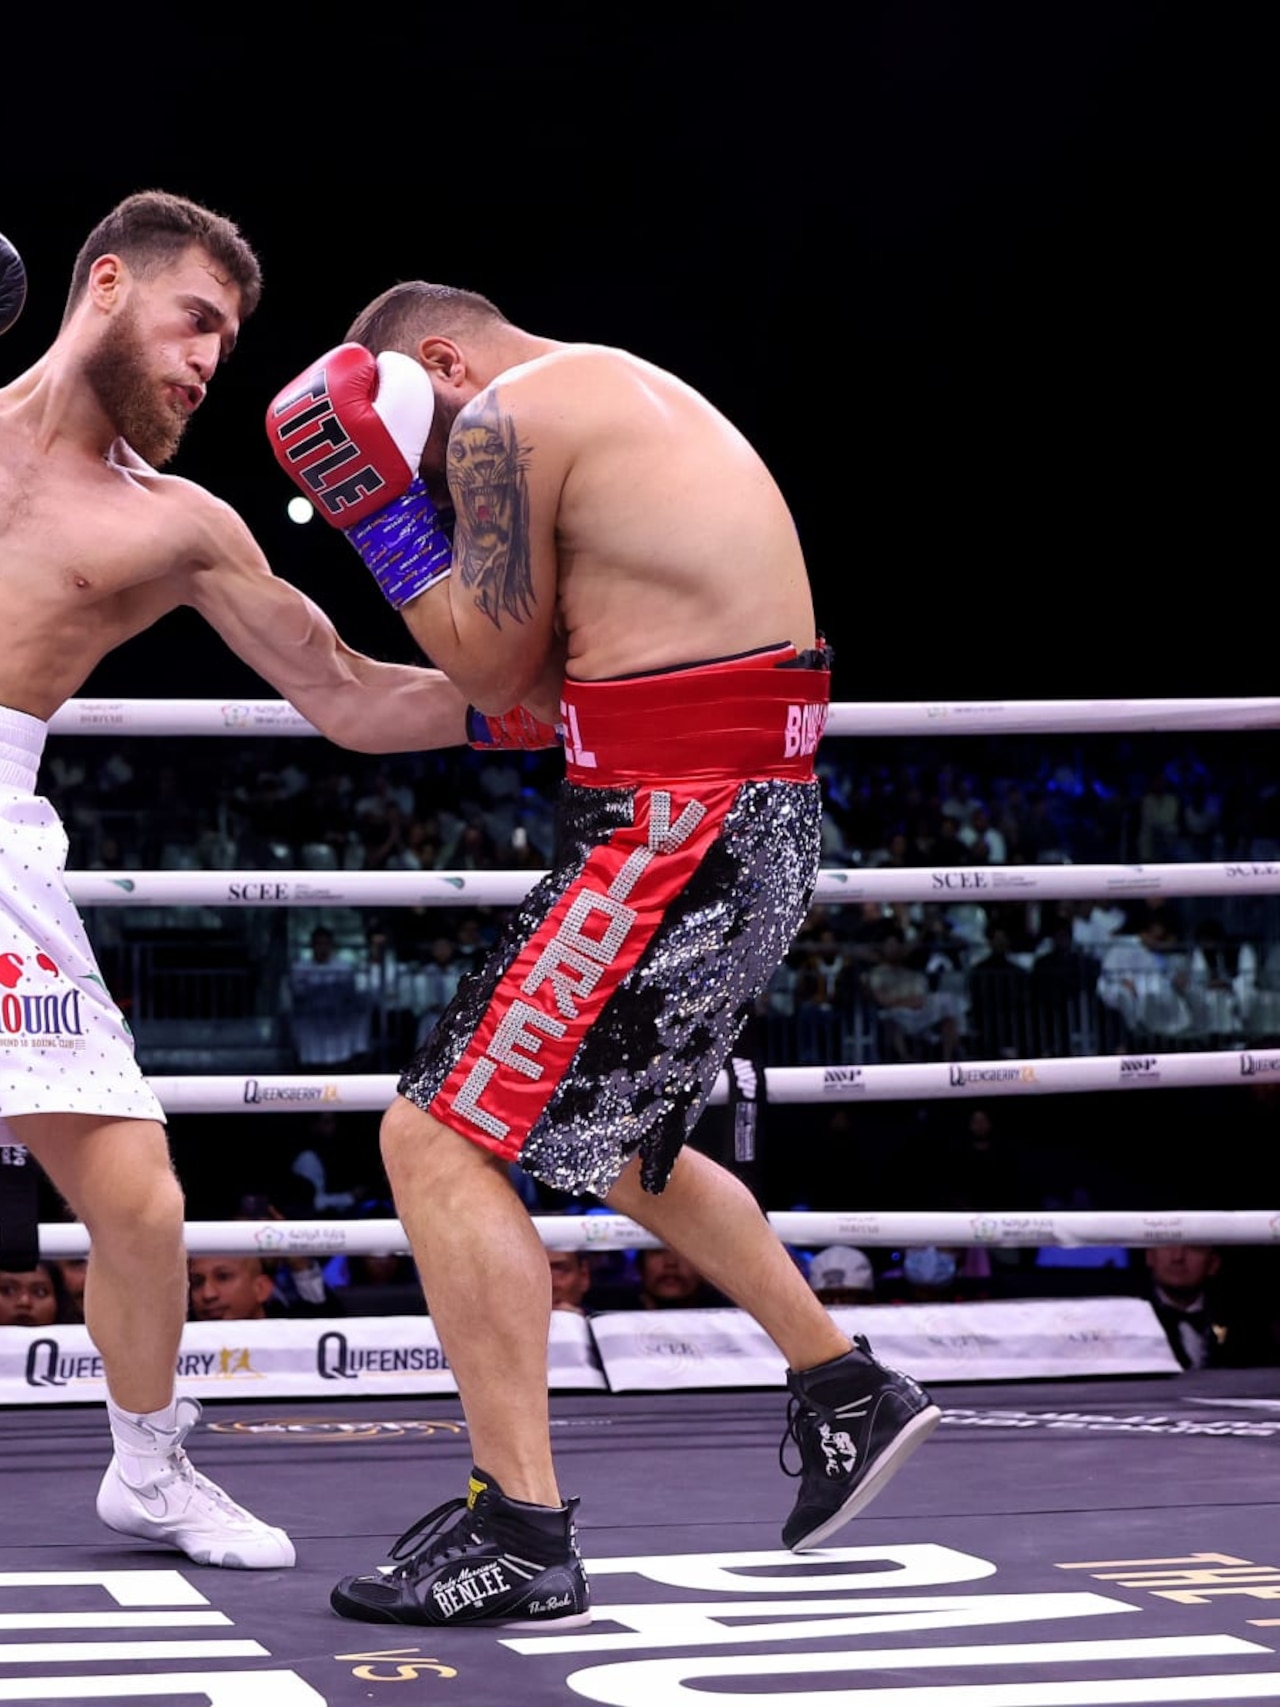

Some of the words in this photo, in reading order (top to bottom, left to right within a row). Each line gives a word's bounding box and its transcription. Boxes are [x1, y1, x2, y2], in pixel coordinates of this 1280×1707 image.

[273, 367, 386, 514] TITLE
[228, 882, 289, 901] SCEE
[932, 871, 987, 889] SCEE
[450, 790, 708, 1141] VIOREL
[25, 1338, 216, 1386] QUEERRY
[317, 1331, 450, 1379] QUEENSBE
[433, 1566, 512, 1619] BENLEE
[333, 1647, 458, 1681] VS
